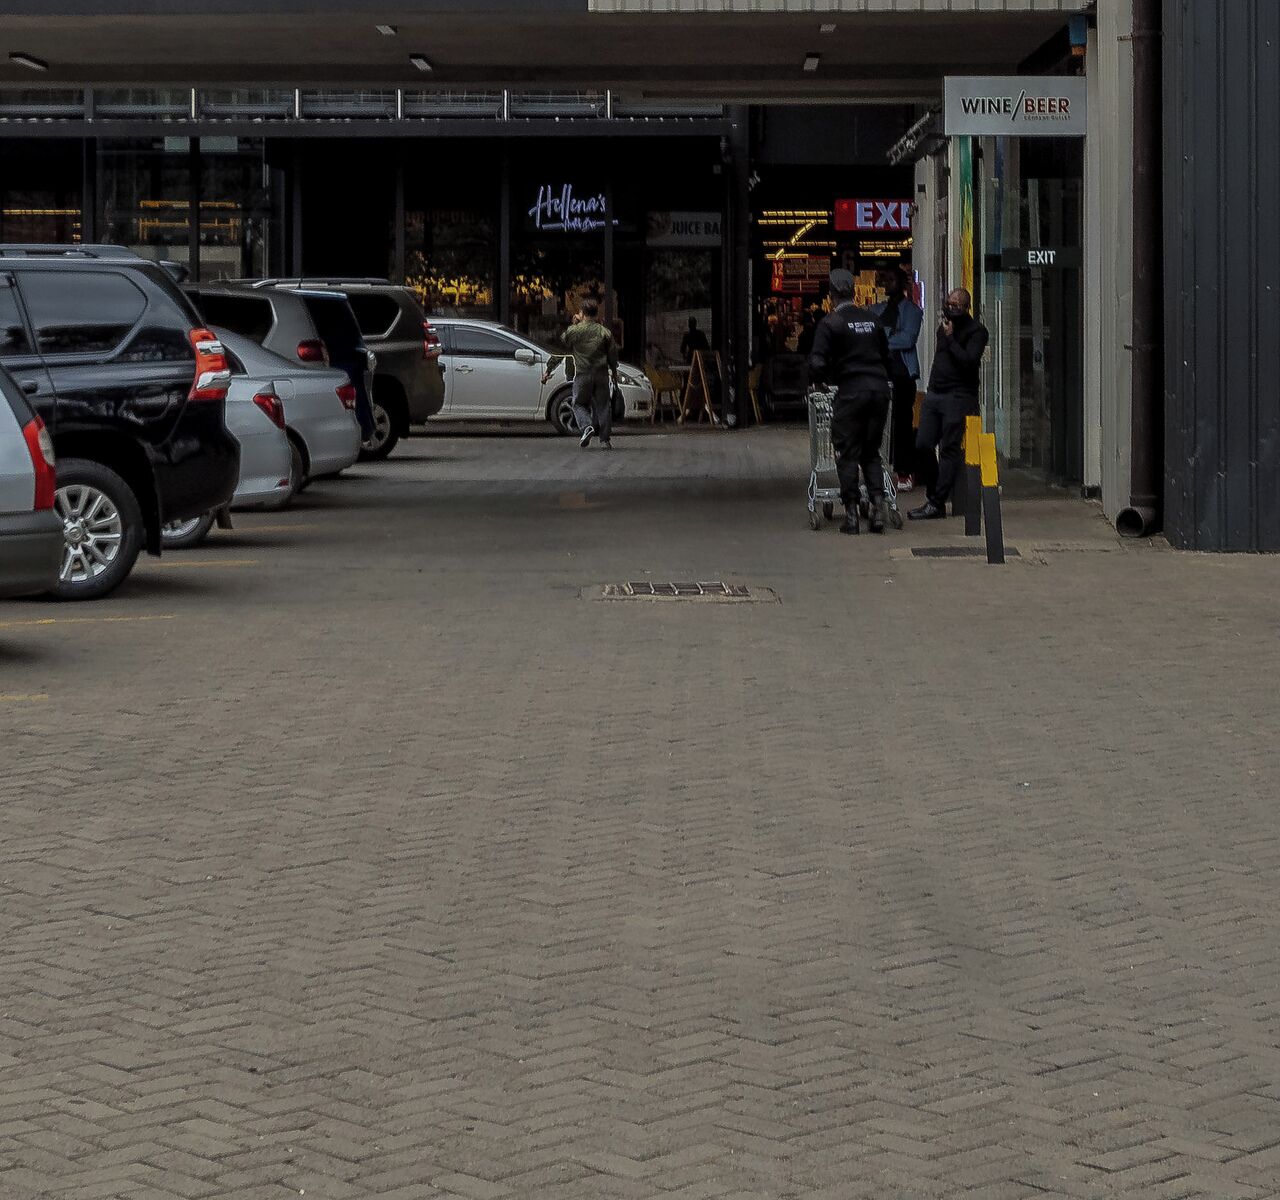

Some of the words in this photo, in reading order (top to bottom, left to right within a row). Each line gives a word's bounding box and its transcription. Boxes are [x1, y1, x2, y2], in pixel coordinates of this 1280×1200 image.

[961, 89, 1070, 121] WINE/BEER
[528, 184, 606, 228] Hellena's
[672, 221, 701, 234] JUICE
[1028, 251, 1056, 264] EXIT
